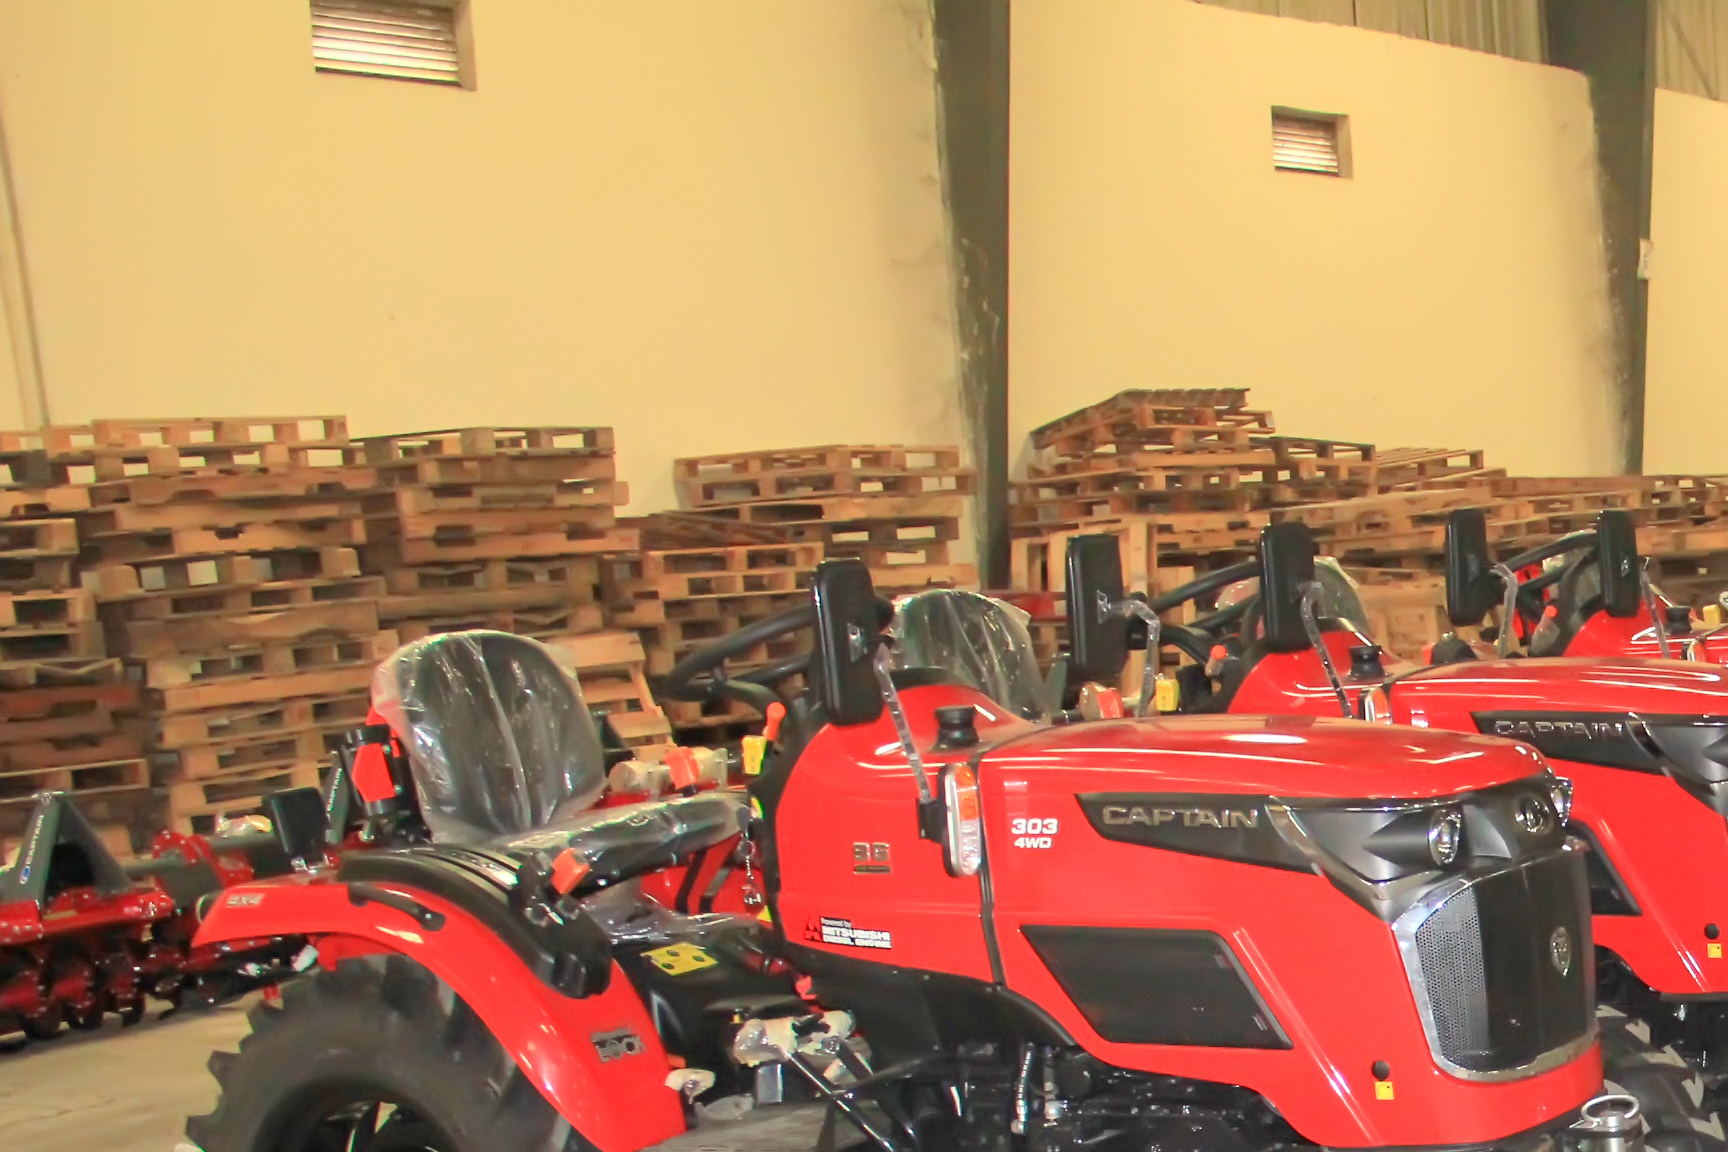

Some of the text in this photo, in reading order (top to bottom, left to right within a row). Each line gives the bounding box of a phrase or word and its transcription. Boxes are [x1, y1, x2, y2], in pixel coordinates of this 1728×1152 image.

[1494, 720, 1624, 741] CAPTAIN
[1102, 805, 1258, 829] CAPTAIN
[1011, 818, 1059, 835] 303
[1014, 837, 1053, 849] 4WD
[821, 926, 891, 941] MITSUBISHI
